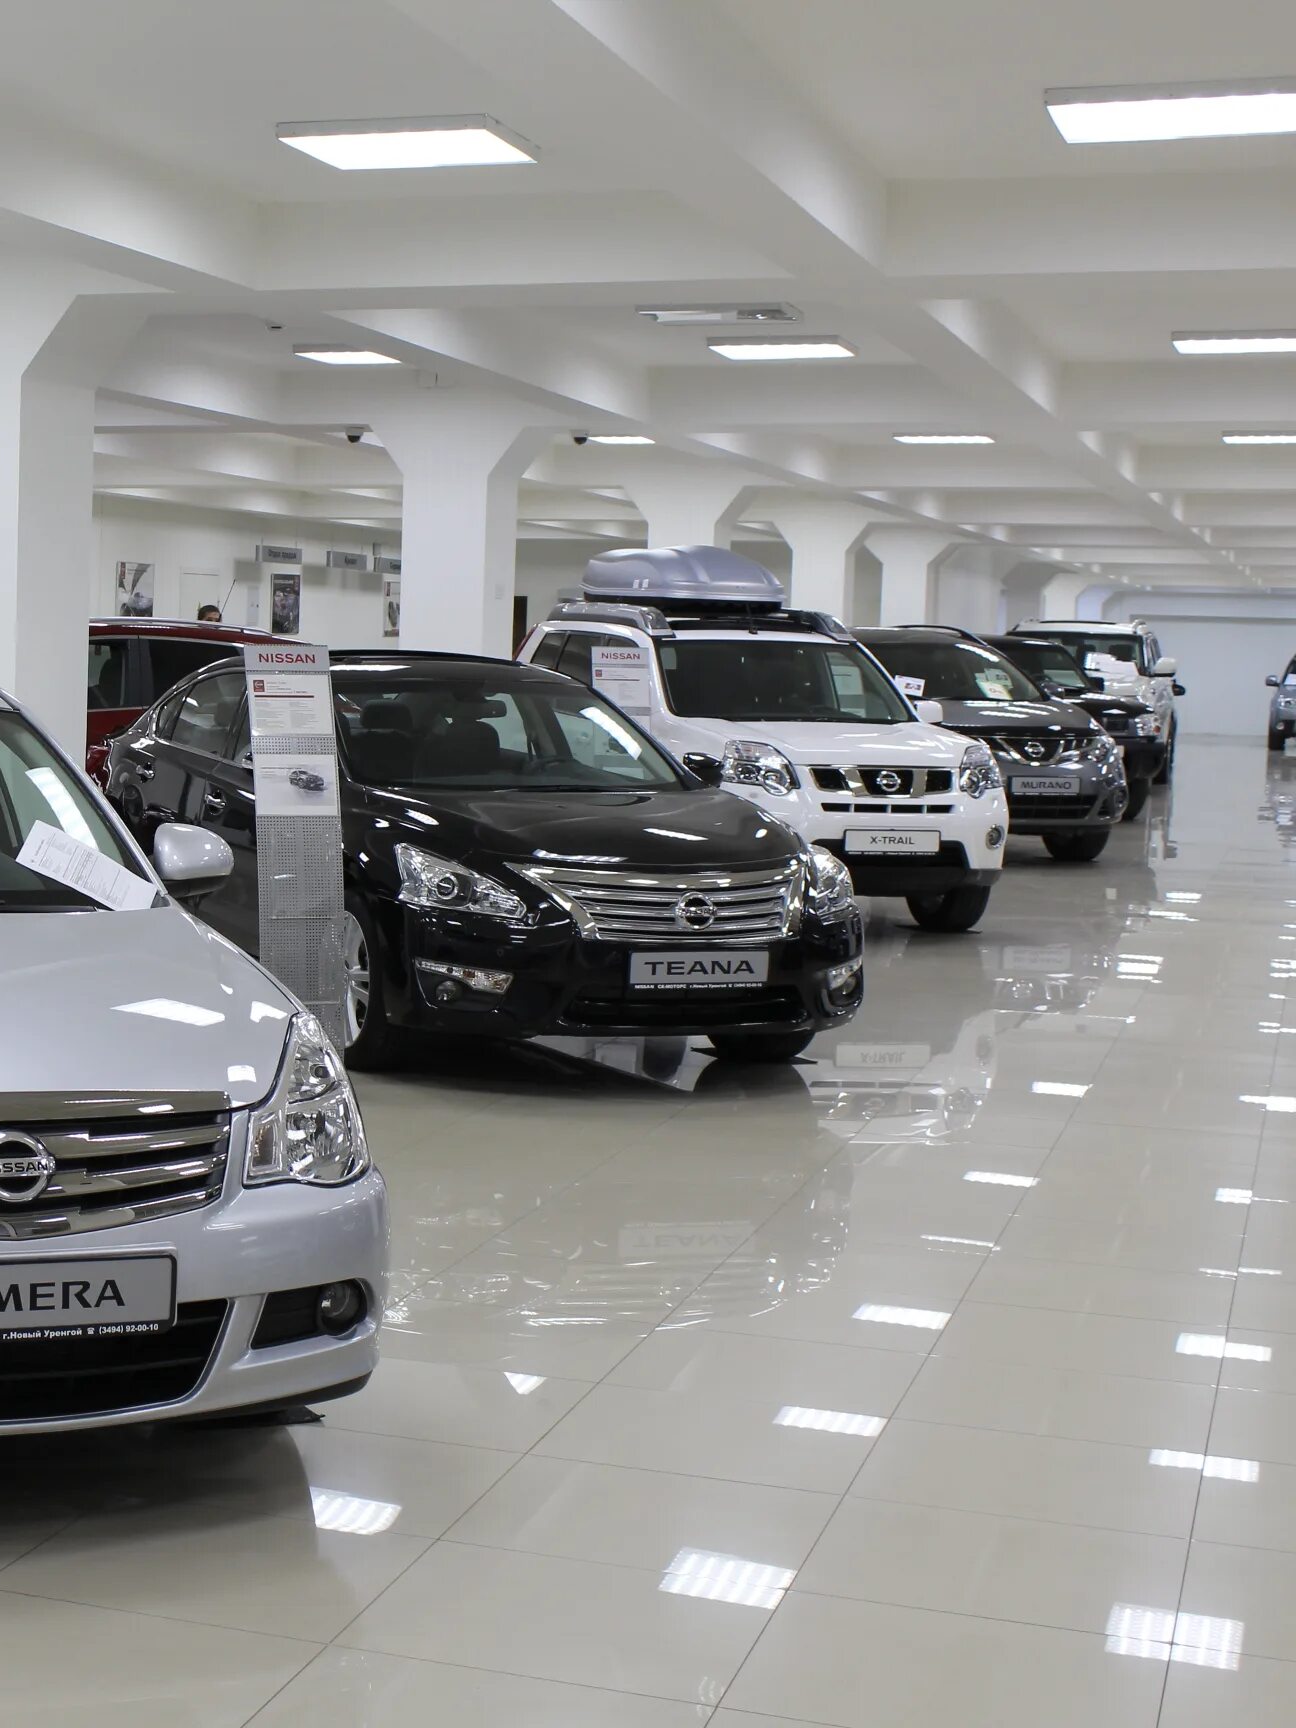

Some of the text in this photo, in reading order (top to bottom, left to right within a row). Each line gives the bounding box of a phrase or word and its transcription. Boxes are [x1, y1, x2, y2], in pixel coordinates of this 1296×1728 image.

[258, 653, 316, 663] NISSAN
[601, 652, 641, 660] NISSAN
[1020, 781, 1072, 790] MURANO
[870, 836, 915, 845] X-TRAIL
[644, 960, 755, 976] TEANA
[2, 1329, 41, 1340] г.Новый
[44, 1327, 82, 1338] Уренгой
[99, 1324, 124, 1335] (3494)
[125, 1323, 159, 1332] 92-00-10
